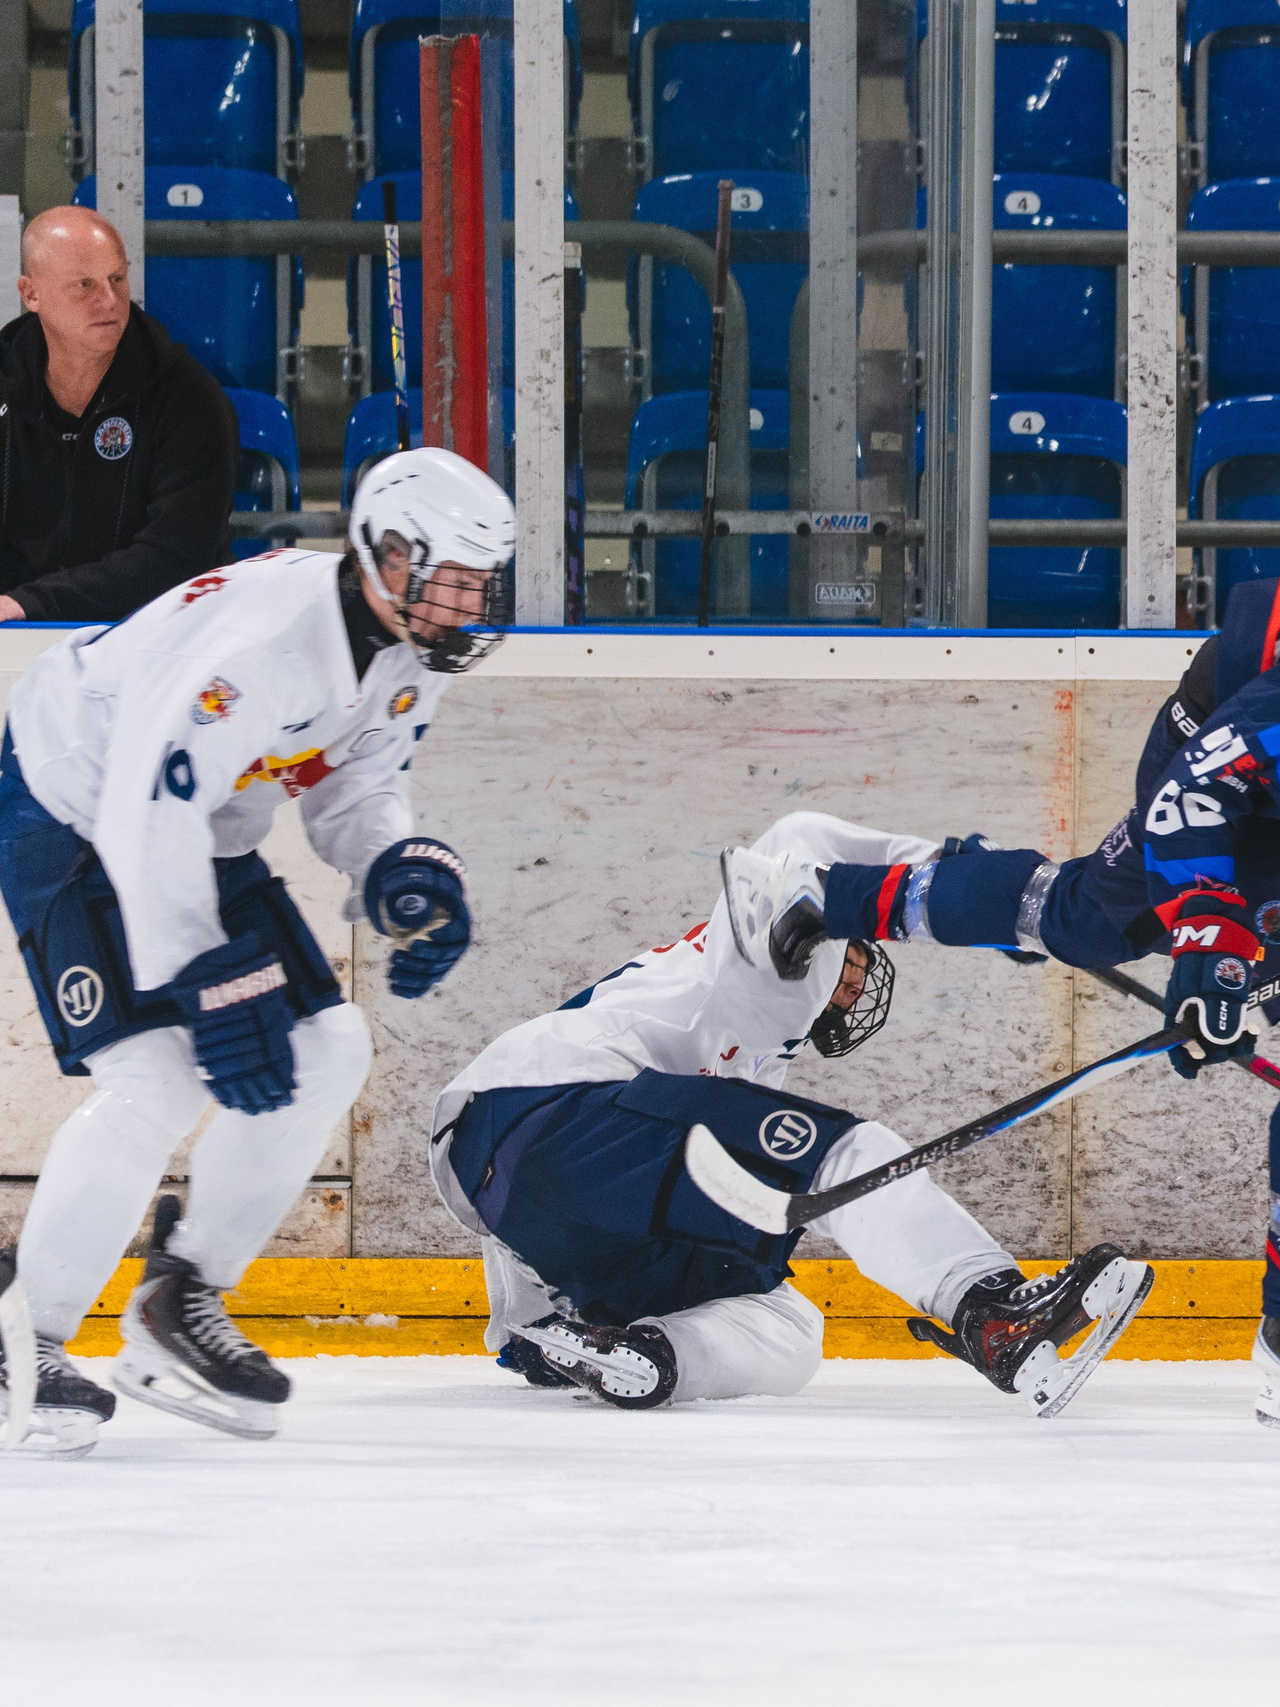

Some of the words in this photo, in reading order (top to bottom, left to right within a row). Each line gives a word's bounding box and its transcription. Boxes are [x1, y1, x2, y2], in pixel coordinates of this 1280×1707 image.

[182, 190, 188, 205] 1
[741, 194, 751, 209] 3
[1017, 197, 1028, 211] 4
[1022, 417, 1032, 432] 4
[829, 514, 868, 528] RAITA
[1219, 1000, 1229, 1031] CCM
